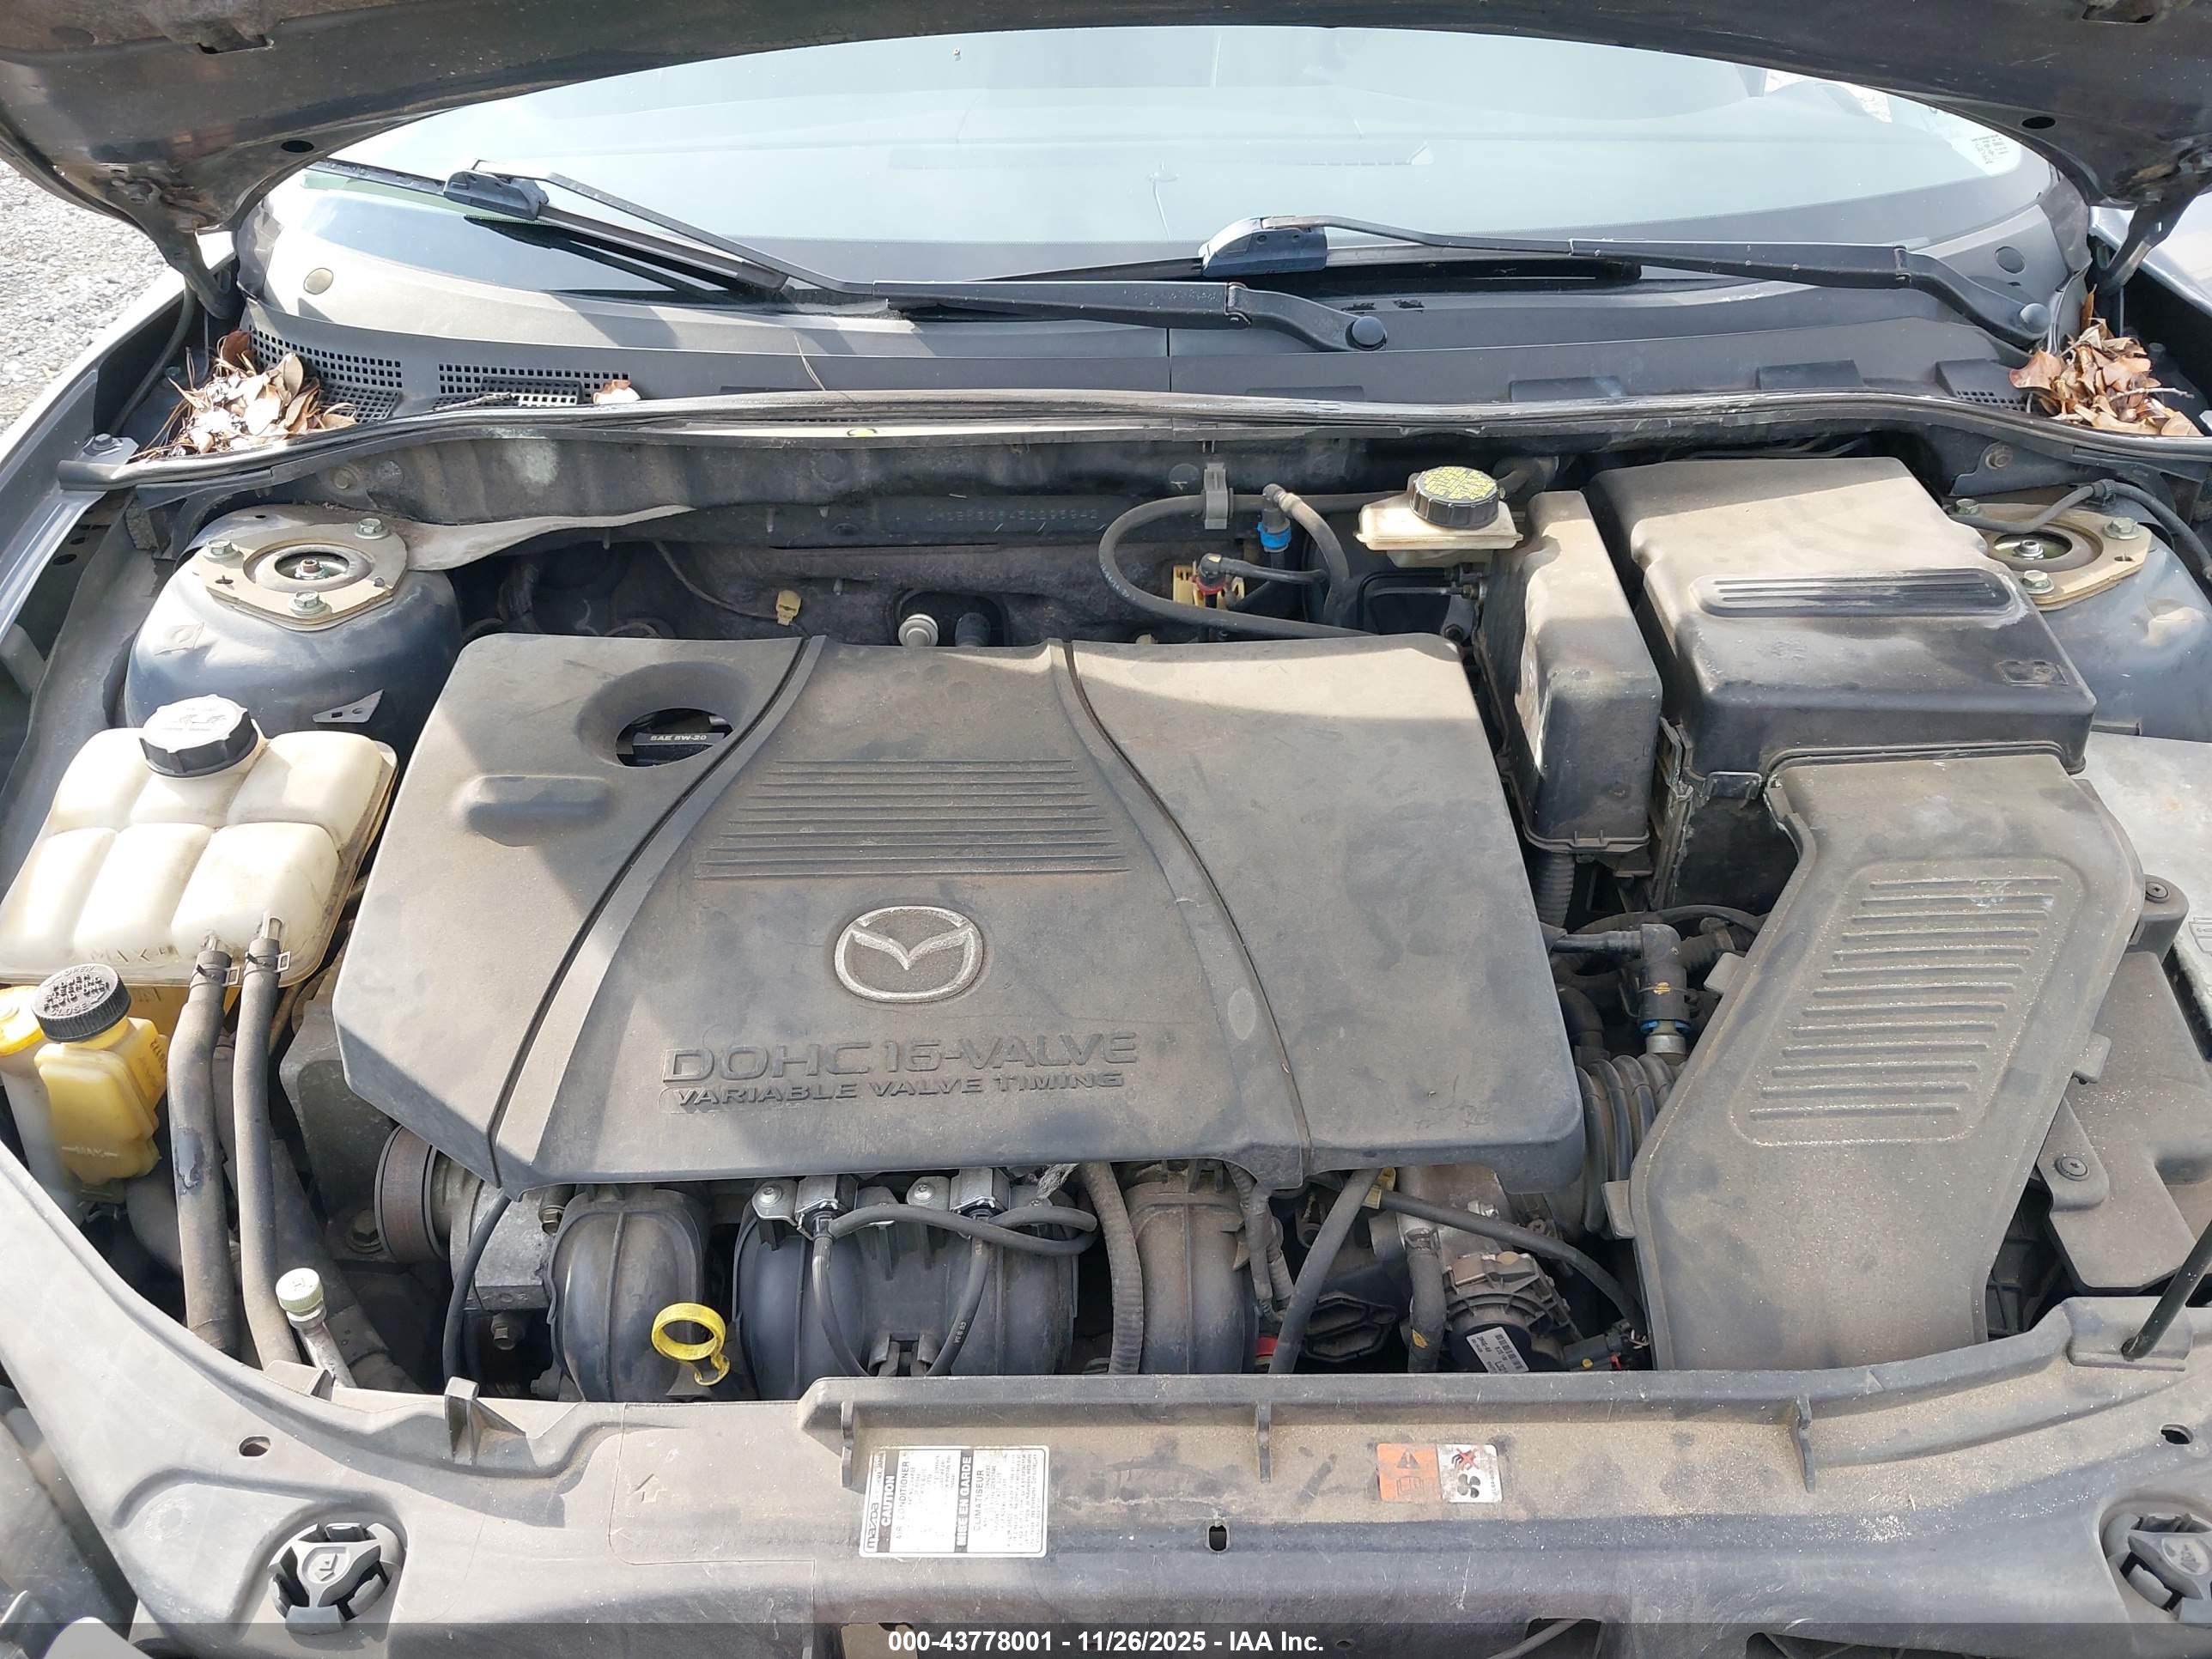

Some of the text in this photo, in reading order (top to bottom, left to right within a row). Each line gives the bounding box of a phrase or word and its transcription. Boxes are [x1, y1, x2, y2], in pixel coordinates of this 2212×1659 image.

[51, 1002, 88, 1017] CLOSE
[663, 1042, 871, 1083] DOHC
[672, 1073, 1124, 1105] VARIABLE VALVE TIMING
[898, 1462, 909, 1520] CONDITIONER
[959, 1456, 973, 1497] GARDE
[881, 1475, 896, 1526] CAUTION
[958, 1498, 969, 1514] EN
[974, 1469, 984, 1531] CLIMATISEUR
[866, 1503, 879, 1548] mazda
